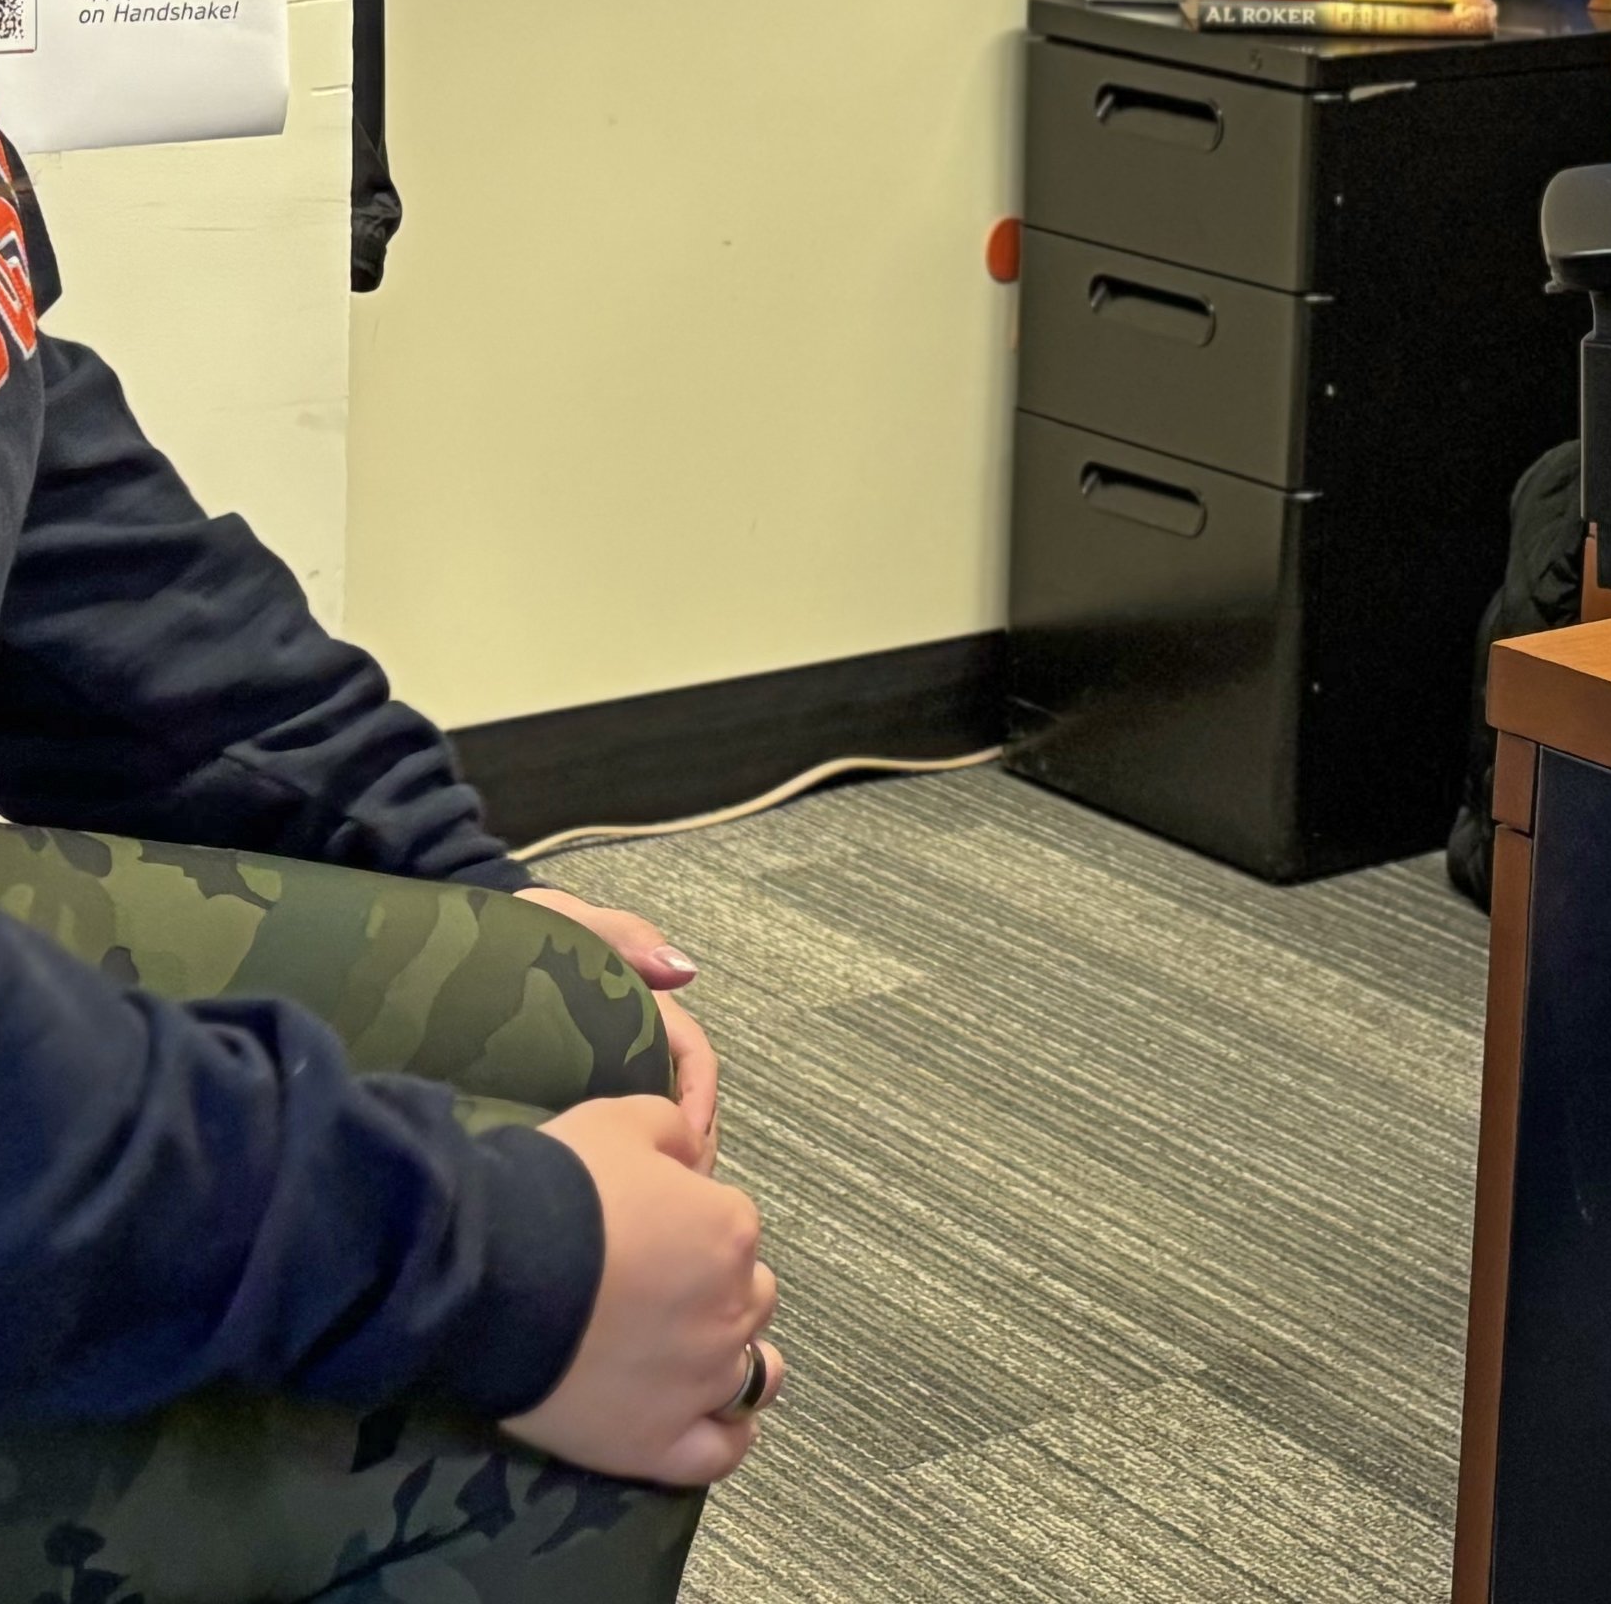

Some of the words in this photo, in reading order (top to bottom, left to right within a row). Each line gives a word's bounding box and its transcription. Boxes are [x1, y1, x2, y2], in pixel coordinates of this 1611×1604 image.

[78, 7, 106, 24] on
[114, 1, 239, 23] Handshake!
[1205, 7, 1236, 23] AL
[1242, 7, 1316, 25] ROKER
